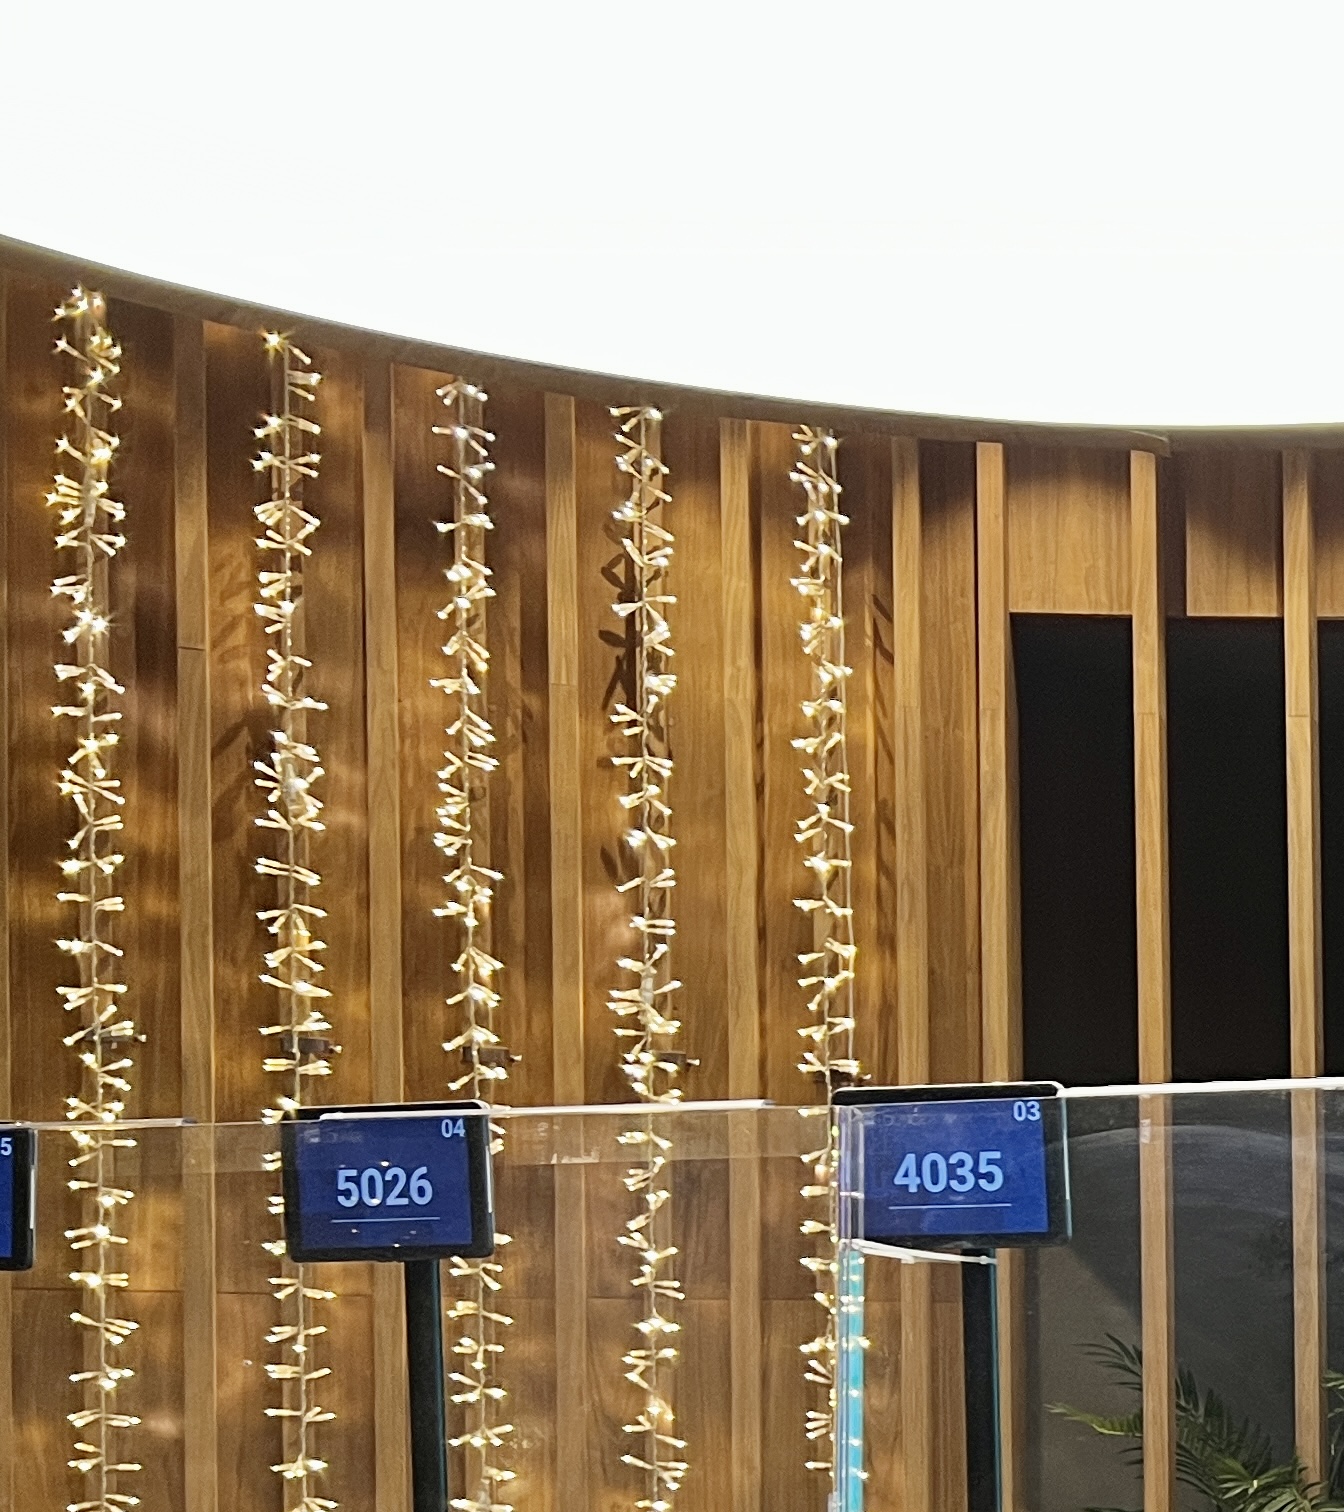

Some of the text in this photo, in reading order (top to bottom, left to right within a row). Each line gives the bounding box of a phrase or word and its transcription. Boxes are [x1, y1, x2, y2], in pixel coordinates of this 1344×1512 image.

[1013, 1101, 1041, 1122] 03
[441, 1118, 466, 1138] 04
[336, 1166, 434, 1208] 5026
[893, 1151, 1005, 1193] 4035
